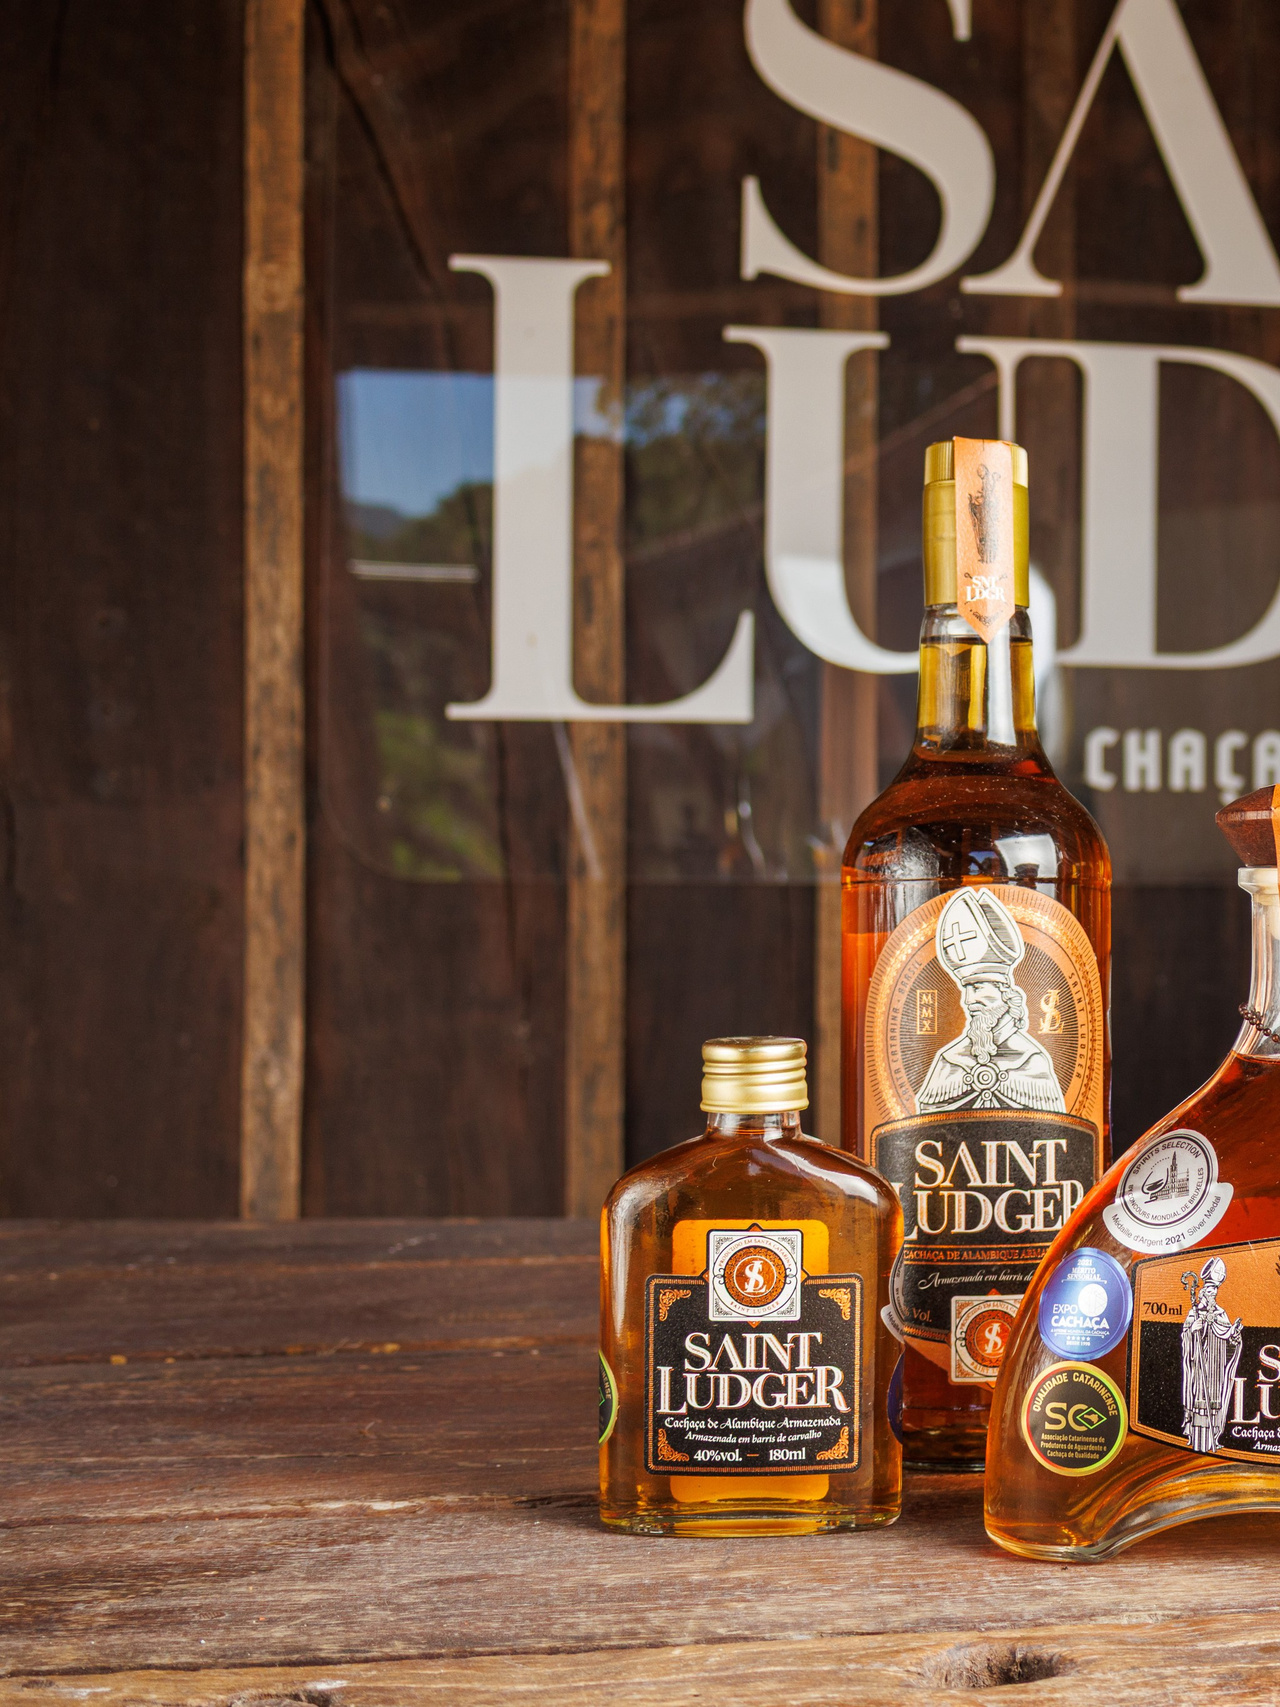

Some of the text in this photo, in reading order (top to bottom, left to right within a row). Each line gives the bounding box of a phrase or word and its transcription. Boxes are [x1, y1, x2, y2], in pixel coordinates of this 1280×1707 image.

[890, 1007, 900, 1063] CATARINA
[1068, 972, 1087, 1079] SAINT LUDGER
[914, 1138, 1068, 1188] SAINT
[1132, 1140, 1202, 1175] SPIRITS SELECTION
[1127, 1192, 1150, 1219] CONCOURS
[1150, 1211, 1181, 1221] MONDIAL
[1181, 1203, 1190, 1213] DE
[1189, 1167, 1204, 1205] BRUXELLES
[1112, 1213, 1133, 1238] Médaille
[1165, 1232, 1186, 1246] 2021
[1186, 1218, 1206, 1237] Silver
[1204, 1195, 1222, 1220] Medal
[903, 1249, 945, 1263] CACHAÇA
[947, 1250, 960, 1260] DE
[961, 1249, 1019, 1260] ALAMBIQUE
[918, 1270, 983, 1290] Armazenada
[984, 1274, 998, 1282] em
[998, 1269, 1023, 1281] barris
[1052, 1304, 1078, 1314] EXPO
[1051, 1315, 1110, 1330] CACHAÇA
[684, 1332, 823, 1372] SAINT
[656, 1365, 851, 1415] LUDGER
[1033, 1372, 1118, 1417] QUALIDADE CATARINENSE
[664, 1416, 841, 1432] Cachaça de Alambique Armazenada
[1044, 1401, 1089, 1432] SC
[685, 1430, 822, 1444] Armazenada em barris de carvalho
[1041, 1433, 1068, 1442] Associação
[1068, 1434, 1098, 1443] Catarinense
[1231, 1426, 1275, 1440] Cachaça
[769, 1447, 806, 1461] 180ml
[1040, 1441, 1067, 1450] Produtores
[1067, 1442, 1074, 1450] de
[1074, 1443, 1103, 1452] Aguardente
[1047, 1450, 1100, 1459] Cachaça de Qualidade
